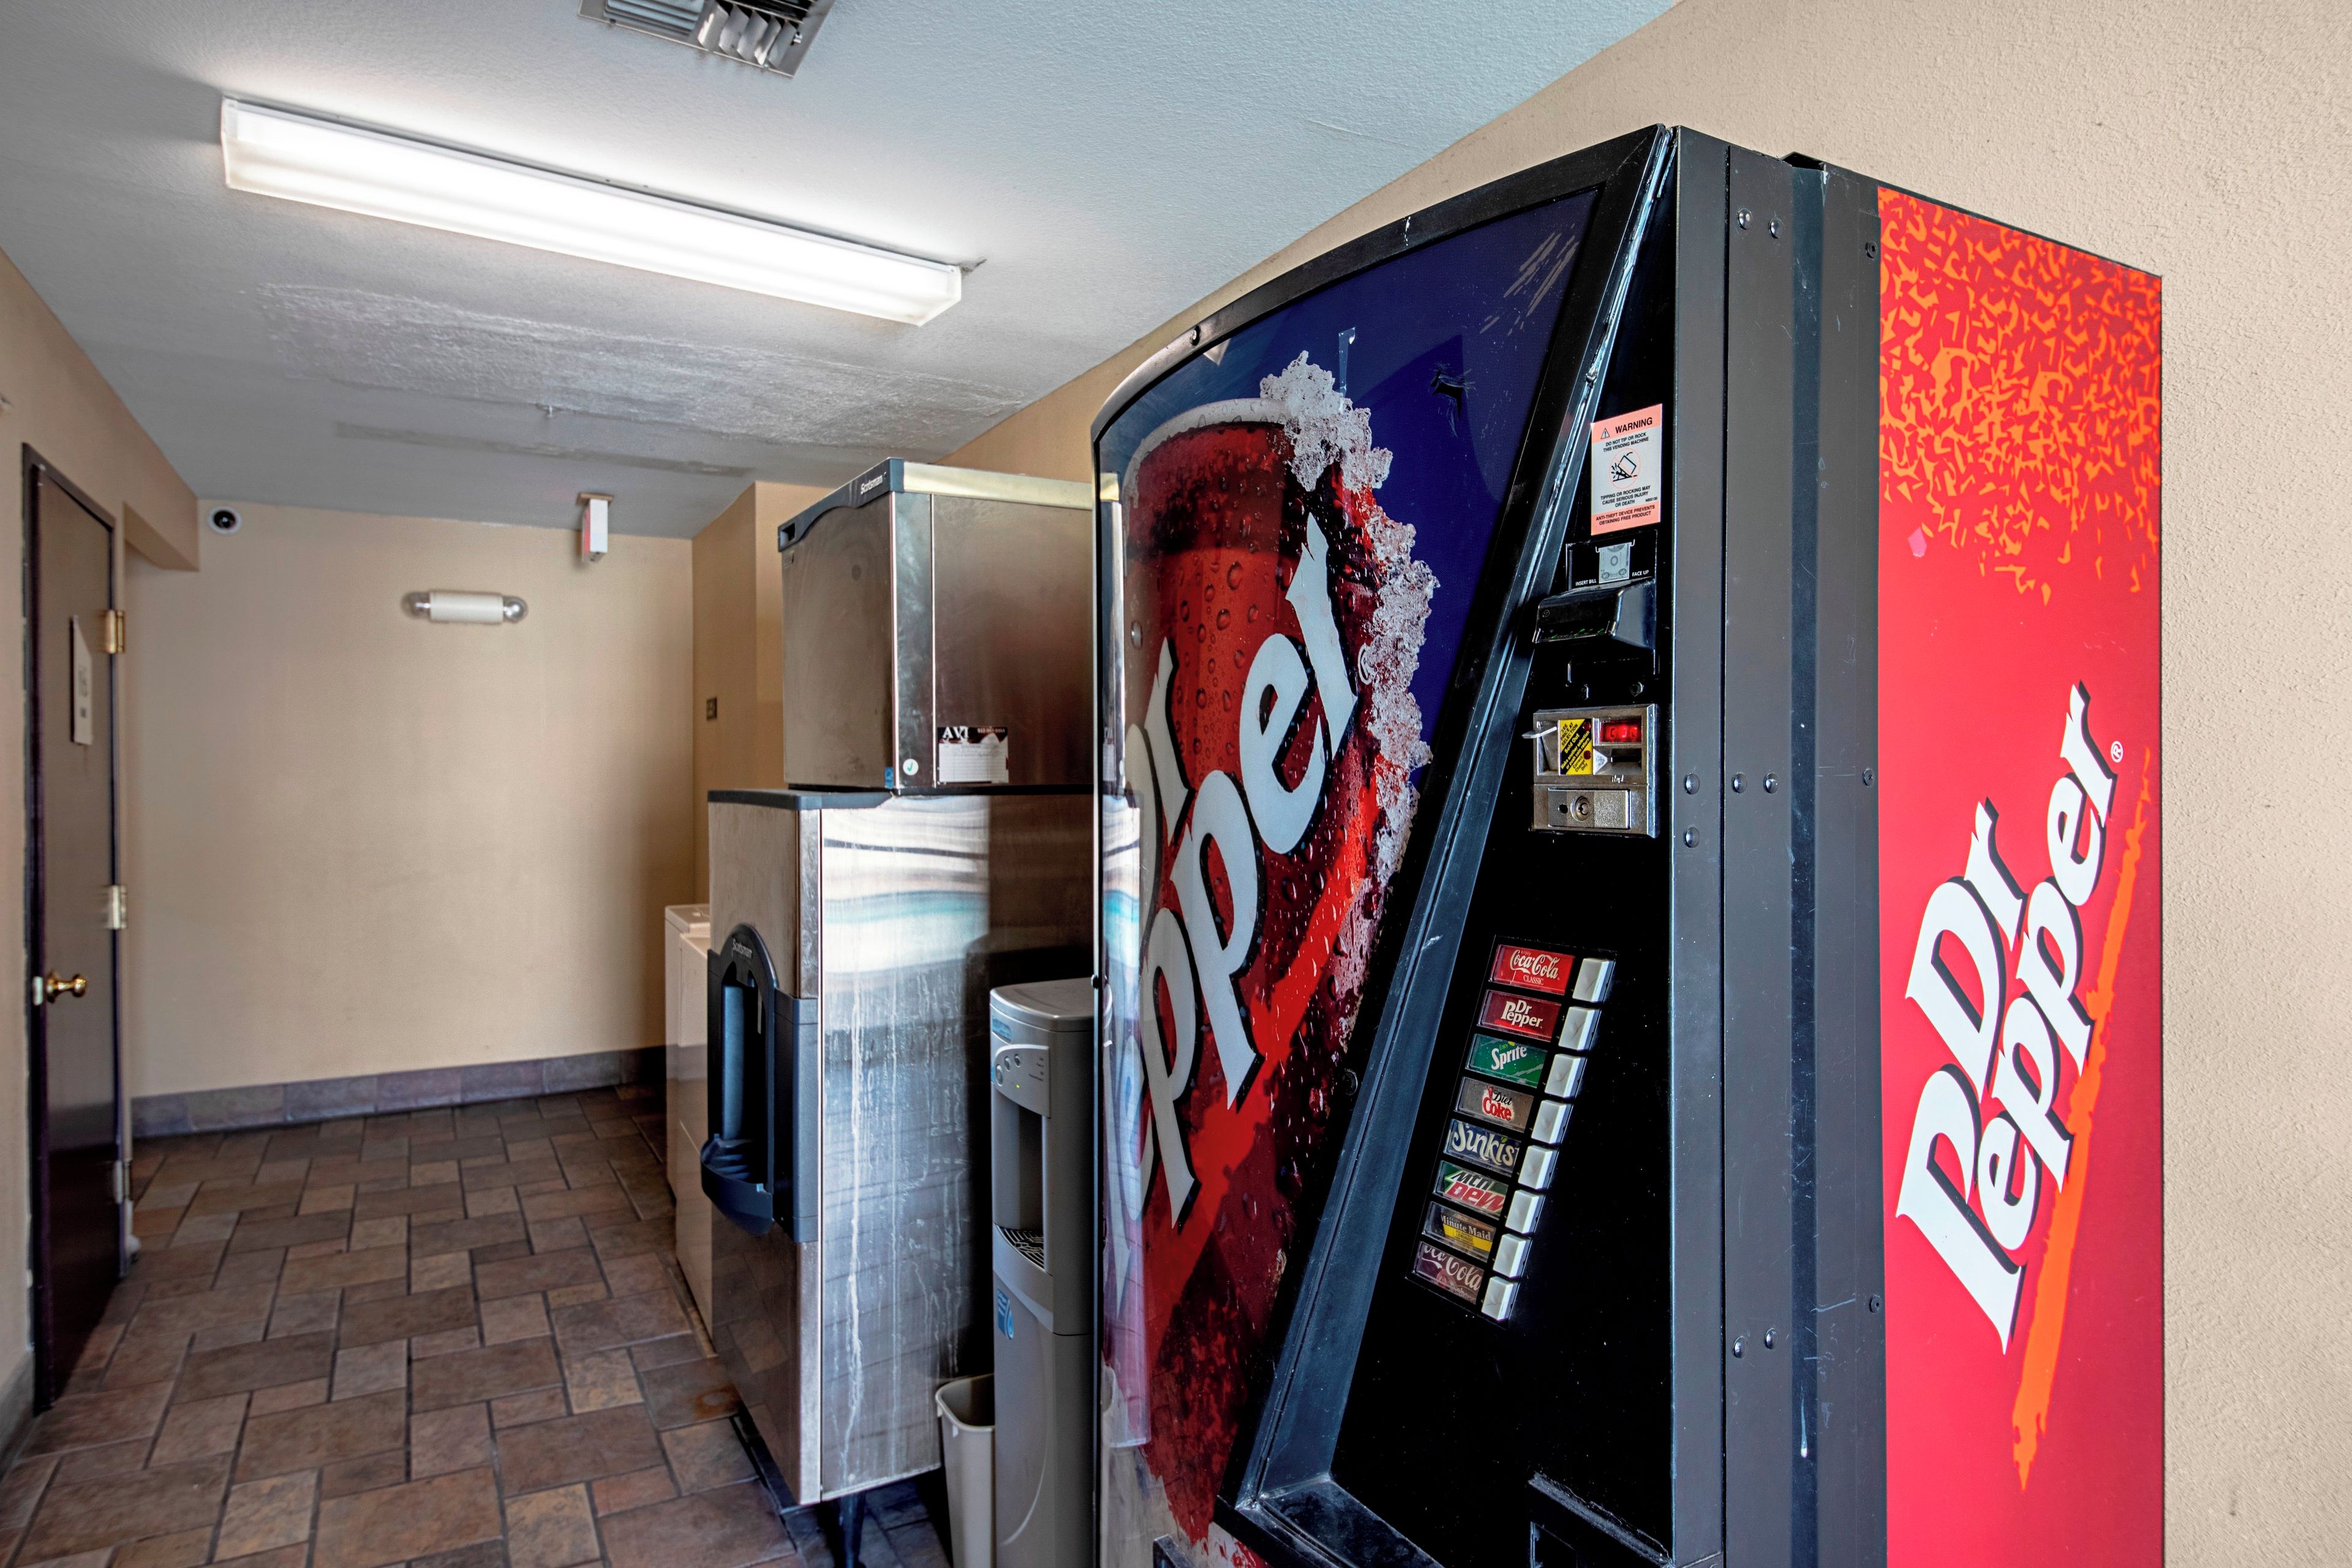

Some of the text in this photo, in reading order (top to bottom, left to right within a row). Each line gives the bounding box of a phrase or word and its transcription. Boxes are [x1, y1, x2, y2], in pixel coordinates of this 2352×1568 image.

[1615, 417, 1653, 434] WARNING
[1613, 442, 1630, 450] VENDING
[1630, 437, 1649, 445] MACHINE
[861, 475, 883, 495] Scotsman
[1596, 512, 1619, 521] ANTI-THEFT
[1634, 505, 1655, 513] PREVENTS
[1599, 517, 1620, 526] OBTAINING
[1561, 723, 1578, 746] SELECTION
[1581, 737, 1590, 749] return
[1564, 741, 1573, 754] Sold
[1568, 745, 1578, 760] another
[1577, 730, 1590, 747] selection
[1572, 756, 1583, 769] Correct
[1905, 799, 2026, 1104] Dr
[1510, 949, 1560, 979] Coca-Cola
[1523, 974, 1544, 986] CLASSIC
[1501, 1001, 1543, 1027] Pepper
[1515, 1000, 1532, 1014] Dr
[1896, 682, 2115, 1355] Pepper
[1491, 1046, 1528, 1070] Sprite
[1493, 1090, 1512, 1105] Diet
[1483, 1097, 1512, 1121] Coke
[1450, 1171, 1492, 1190] Mtn
[1441, 1215, 1468, 1233] Minute
[1468, 1225, 1491, 1240] Maid
[1446, 1256, 1483, 1291] Cola
